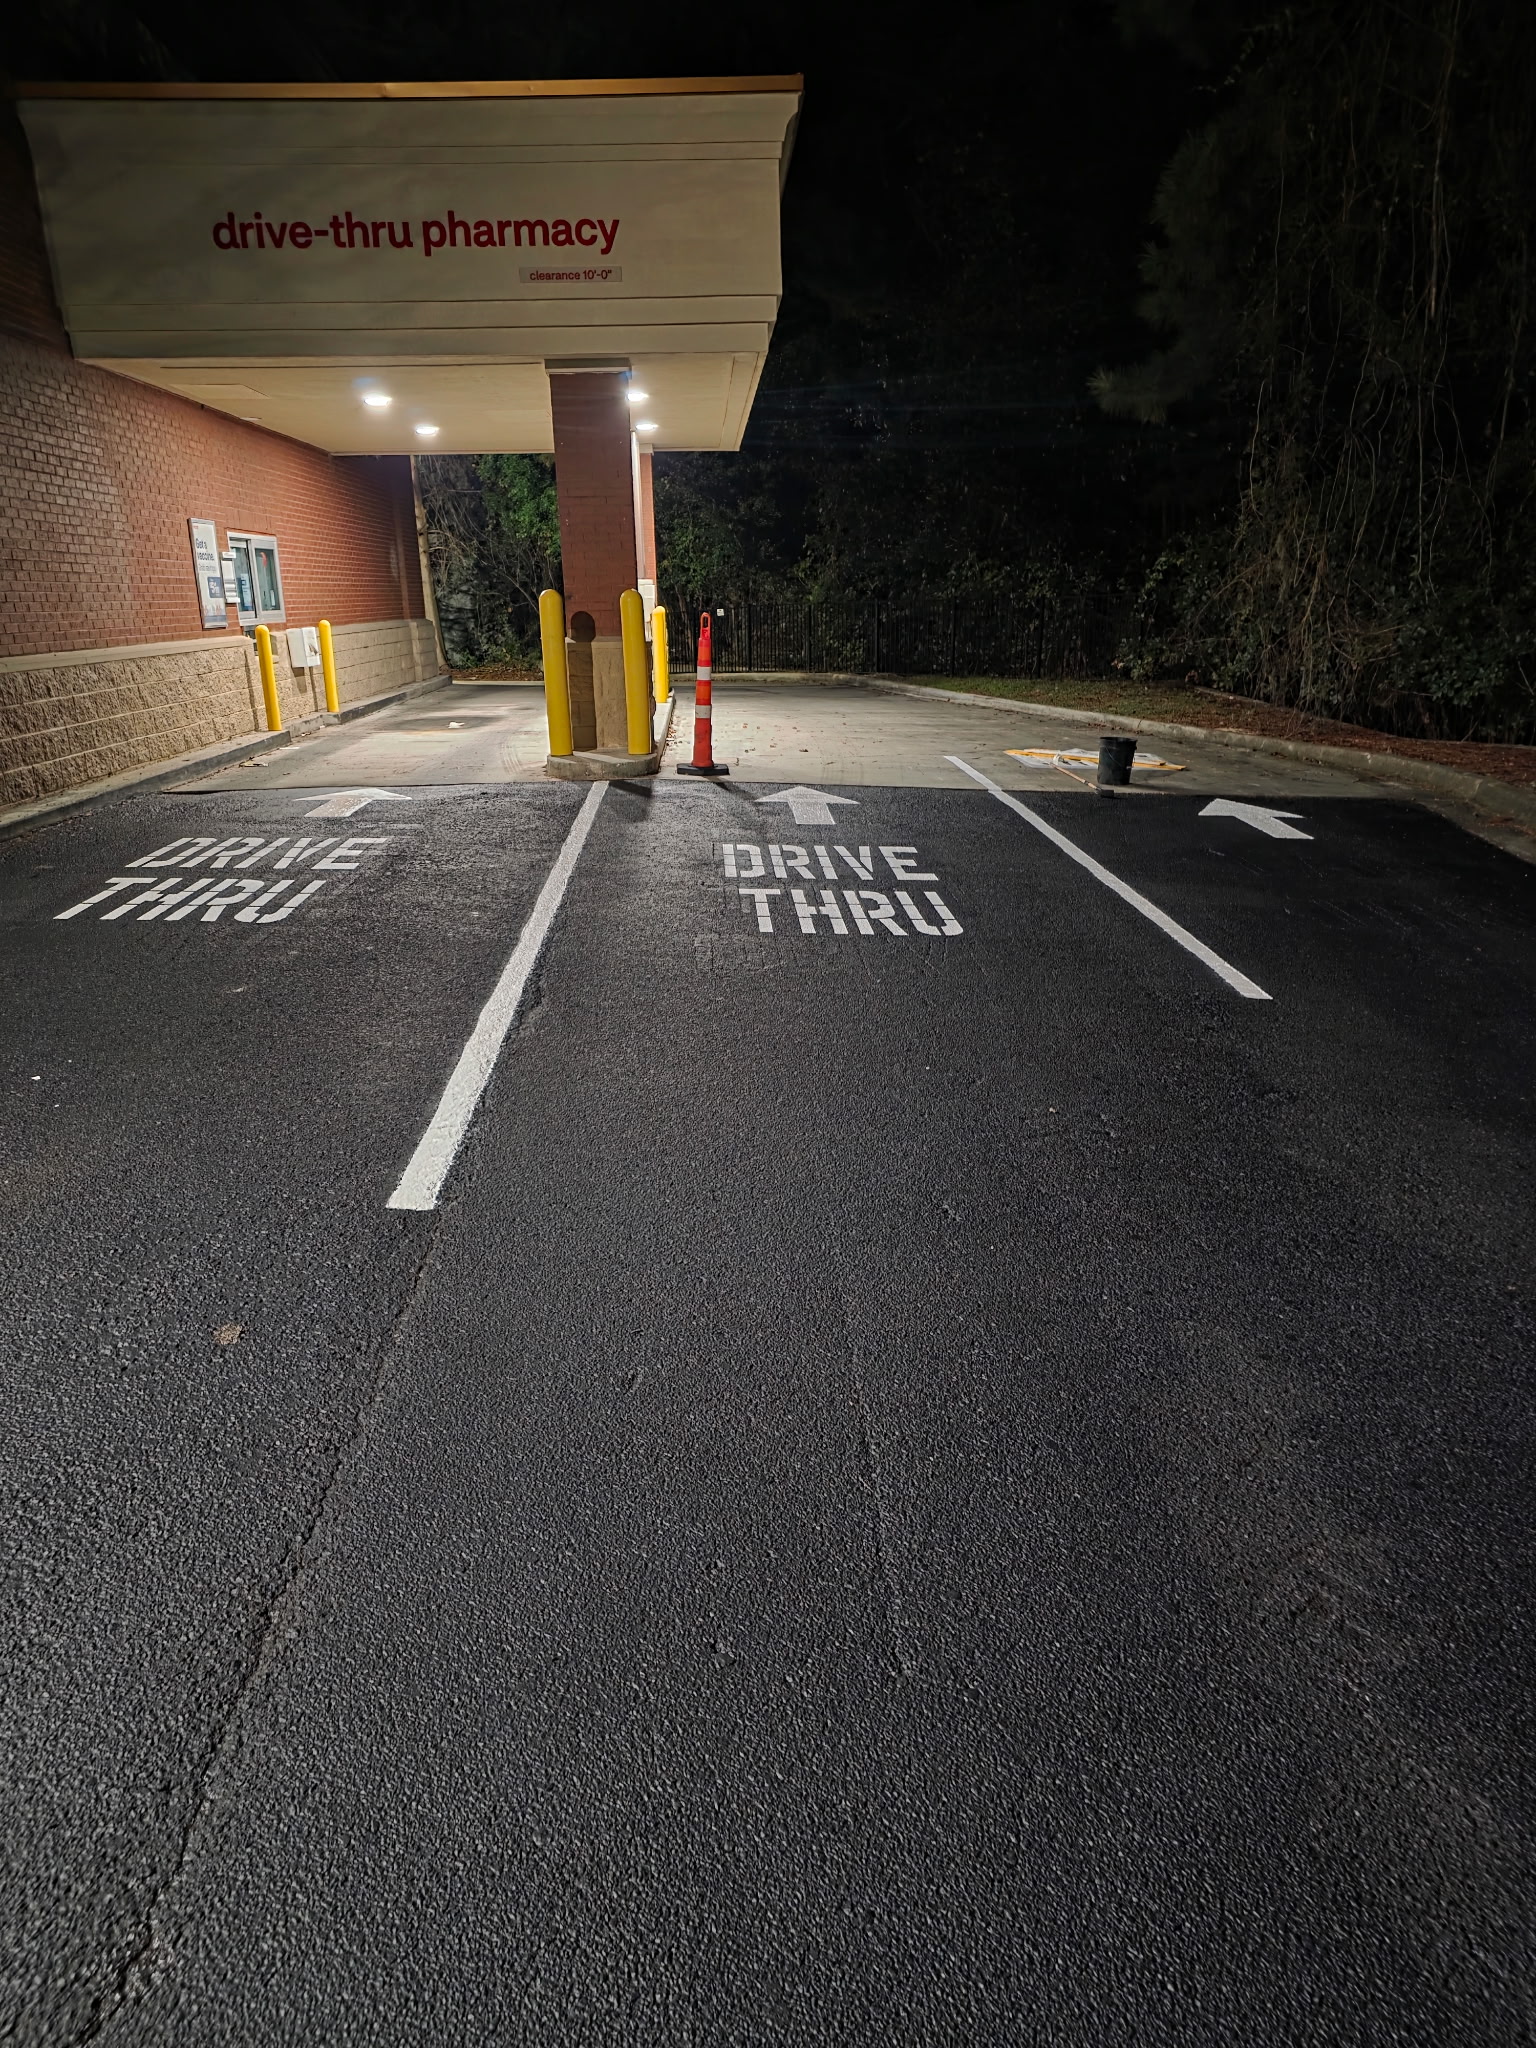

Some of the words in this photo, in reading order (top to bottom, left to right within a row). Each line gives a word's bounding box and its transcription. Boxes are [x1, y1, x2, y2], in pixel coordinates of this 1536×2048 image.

[212, 211, 414, 250] drive-thru
[422, 210, 620, 257] pharmacy
[529, 270, 580, 281] clearance
[582, 269, 613, 281] 10'-0"
[124, 837, 389, 870] DRIVE
[721, 843, 939, 881] DRIVE
[53, 877, 327, 925] THRU
[738, 888, 964, 937] THRU
